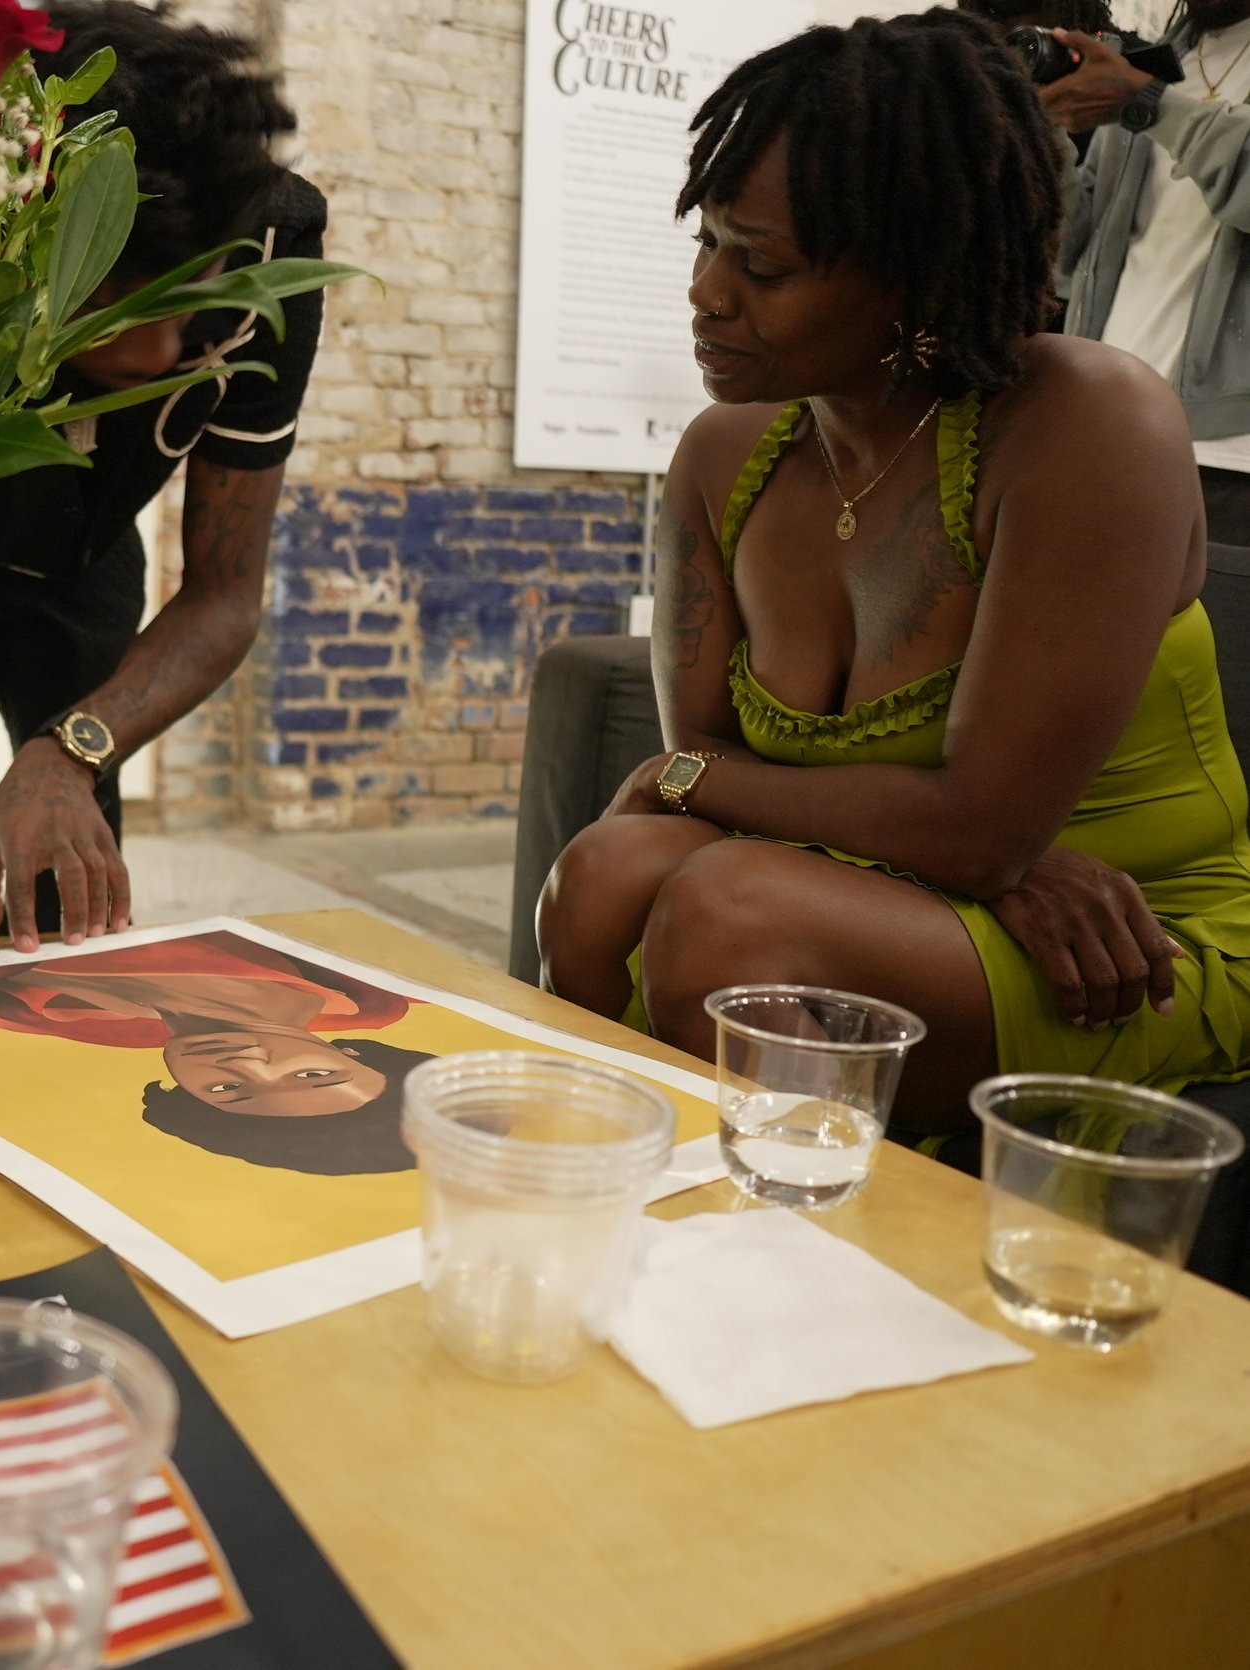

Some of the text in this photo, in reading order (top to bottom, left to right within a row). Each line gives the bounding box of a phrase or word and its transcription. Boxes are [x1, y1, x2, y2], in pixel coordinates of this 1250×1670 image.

[555, 0, 675, 63] CHEERS
[589, 37, 638, 58] TO THE
[554, 40, 690, 101] CULTURE
